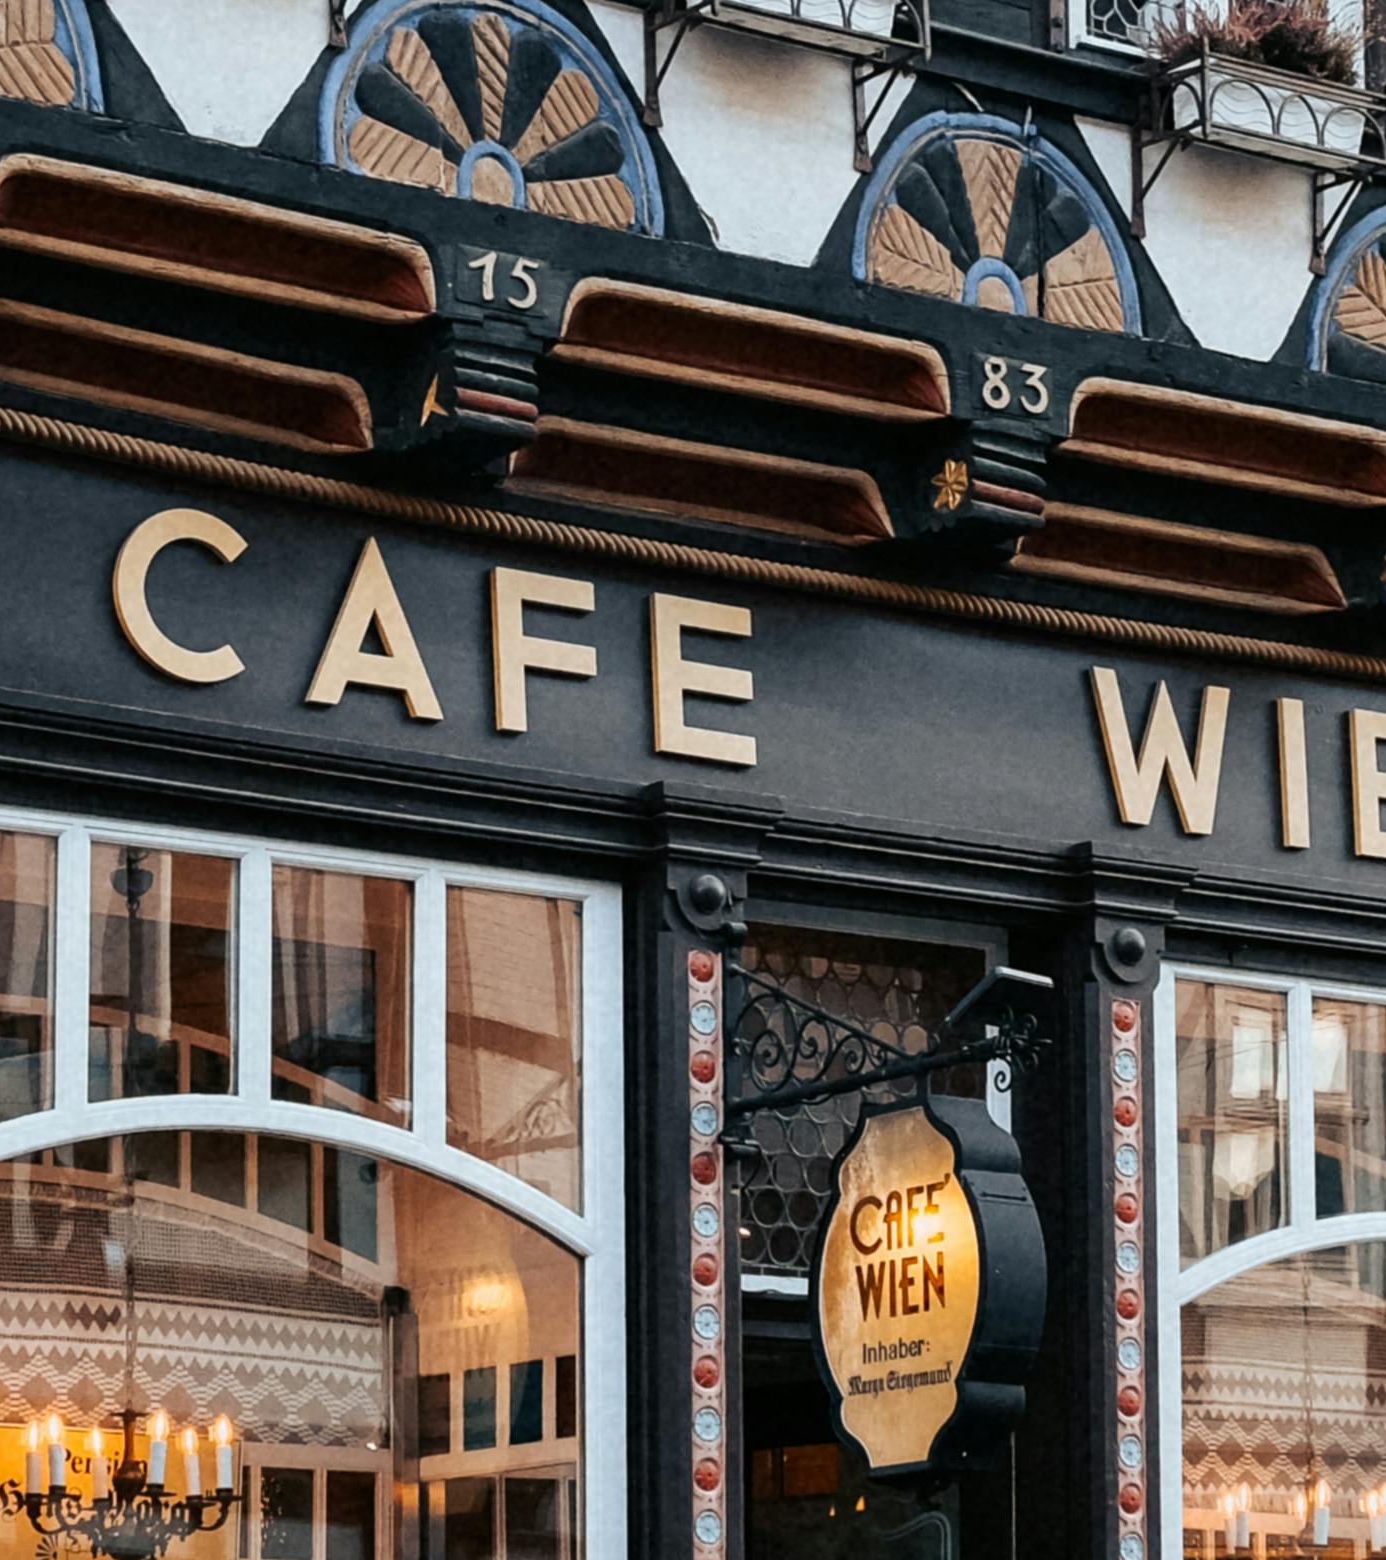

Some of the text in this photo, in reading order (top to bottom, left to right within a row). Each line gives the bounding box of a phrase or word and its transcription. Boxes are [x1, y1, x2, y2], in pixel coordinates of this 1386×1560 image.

[468, 250, 540, 310] 15
[981, 356, 1049, 414] 83
[113, 507, 758, 768] CAFE
[854, 1249, 946, 1322] WIEN
[862, 1337, 931, 1364] Inhaber:
